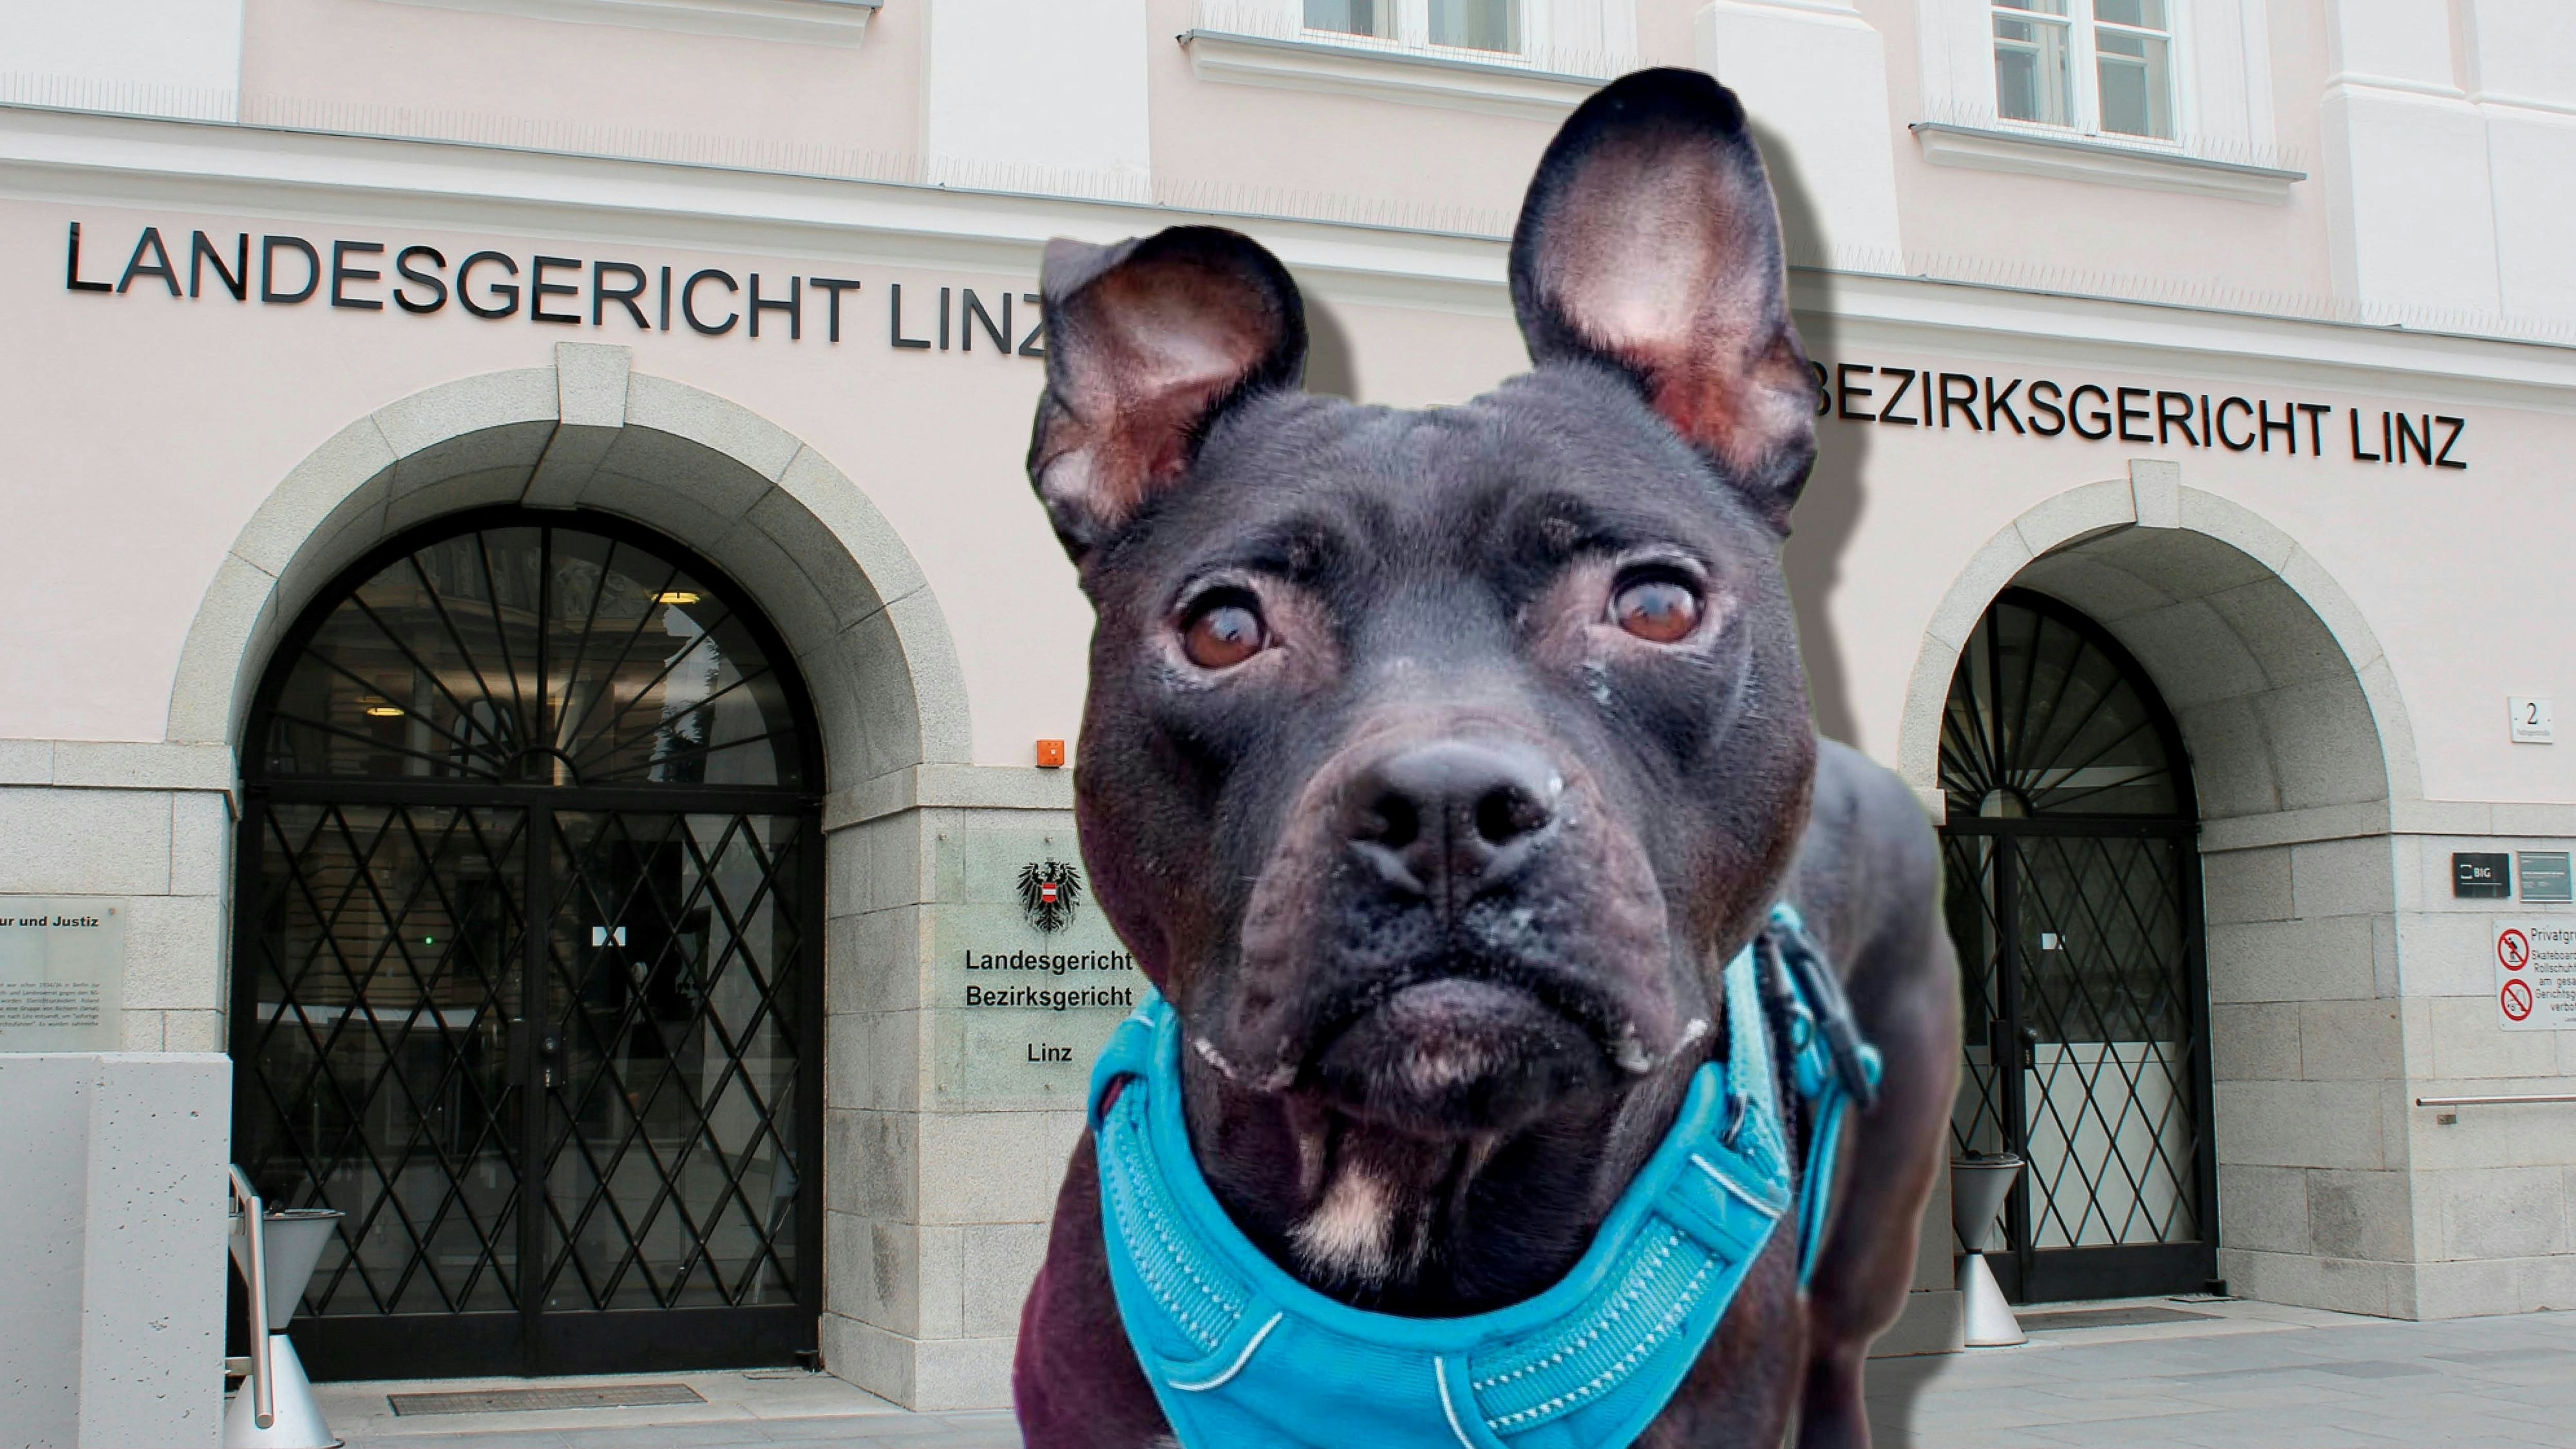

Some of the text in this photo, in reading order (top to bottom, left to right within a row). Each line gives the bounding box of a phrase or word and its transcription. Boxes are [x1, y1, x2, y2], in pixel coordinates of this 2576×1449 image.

[66, 221, 860, 343] LANDESGERICHT
[2349, 408, 2467, 469] LINZ
[2526, 702, 2538, 724] 2
[2474, 867, 2491, 878] BIG
[19, 916, 47, 927] und
[52, 916, 99, 927] Justiz
[966, 950, 1132, 974] Landesgericht
[966, 986, 1132, 1010] Bezirksgericht
[1028, 1043, 1072, 1062] Linz
